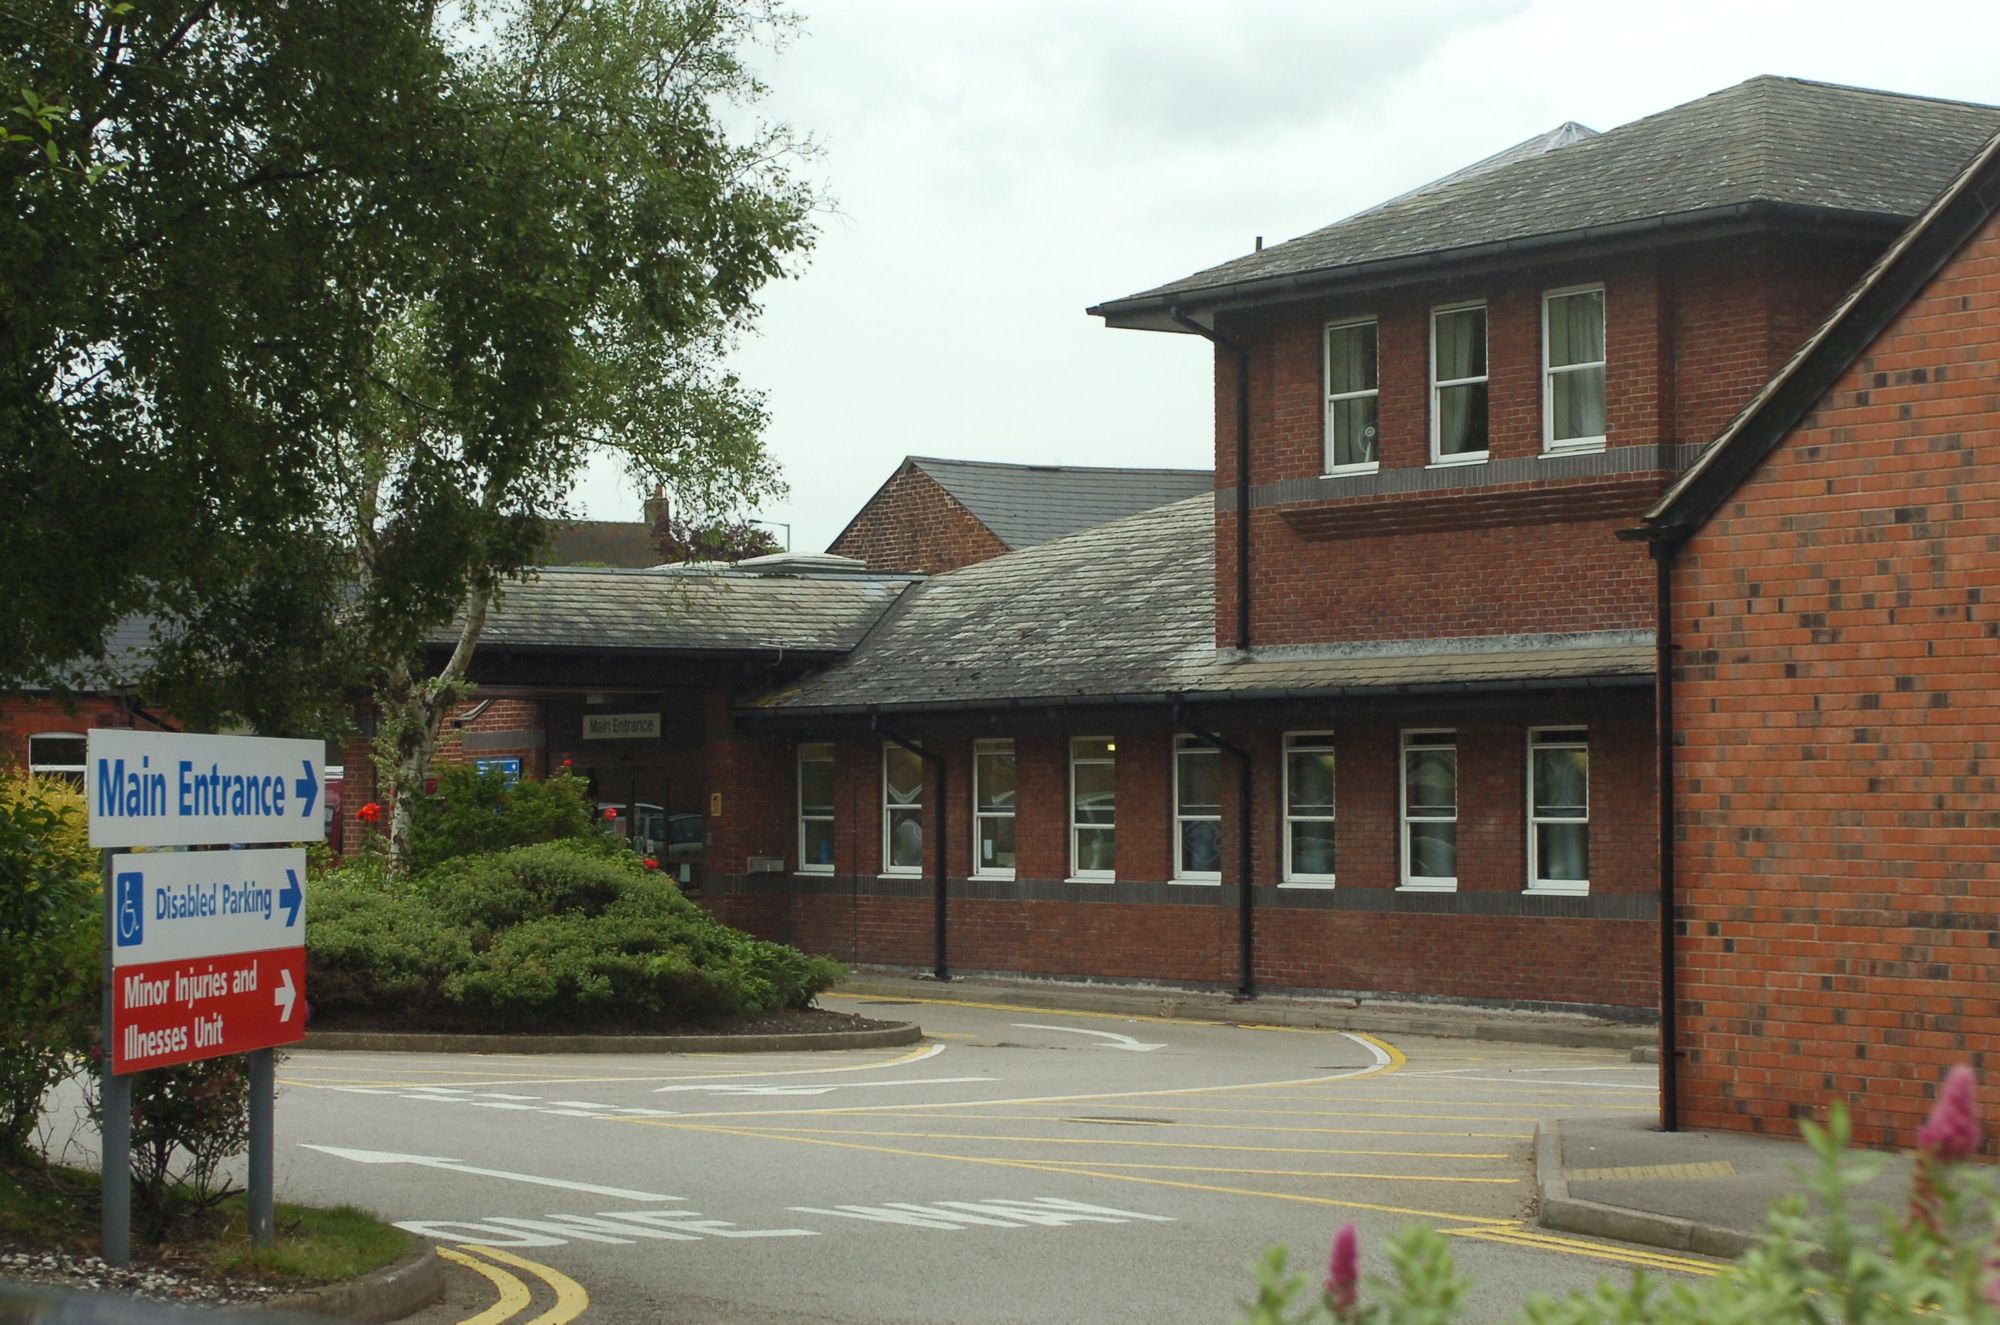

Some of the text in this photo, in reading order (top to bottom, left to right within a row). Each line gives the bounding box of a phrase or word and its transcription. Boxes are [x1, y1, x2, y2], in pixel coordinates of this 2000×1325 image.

[589, 718, 654, 734] Main Entrance
[98, 756, 285, 817] Main Entrance
[156, 881, 272, 920] Disabled Parking
[124, 959, 257, 1009] Minor Injuries and
[124, 1013, 223, 1061] Illnesses Unit
[392, 1197, 1178, 1247] ONE WAY
